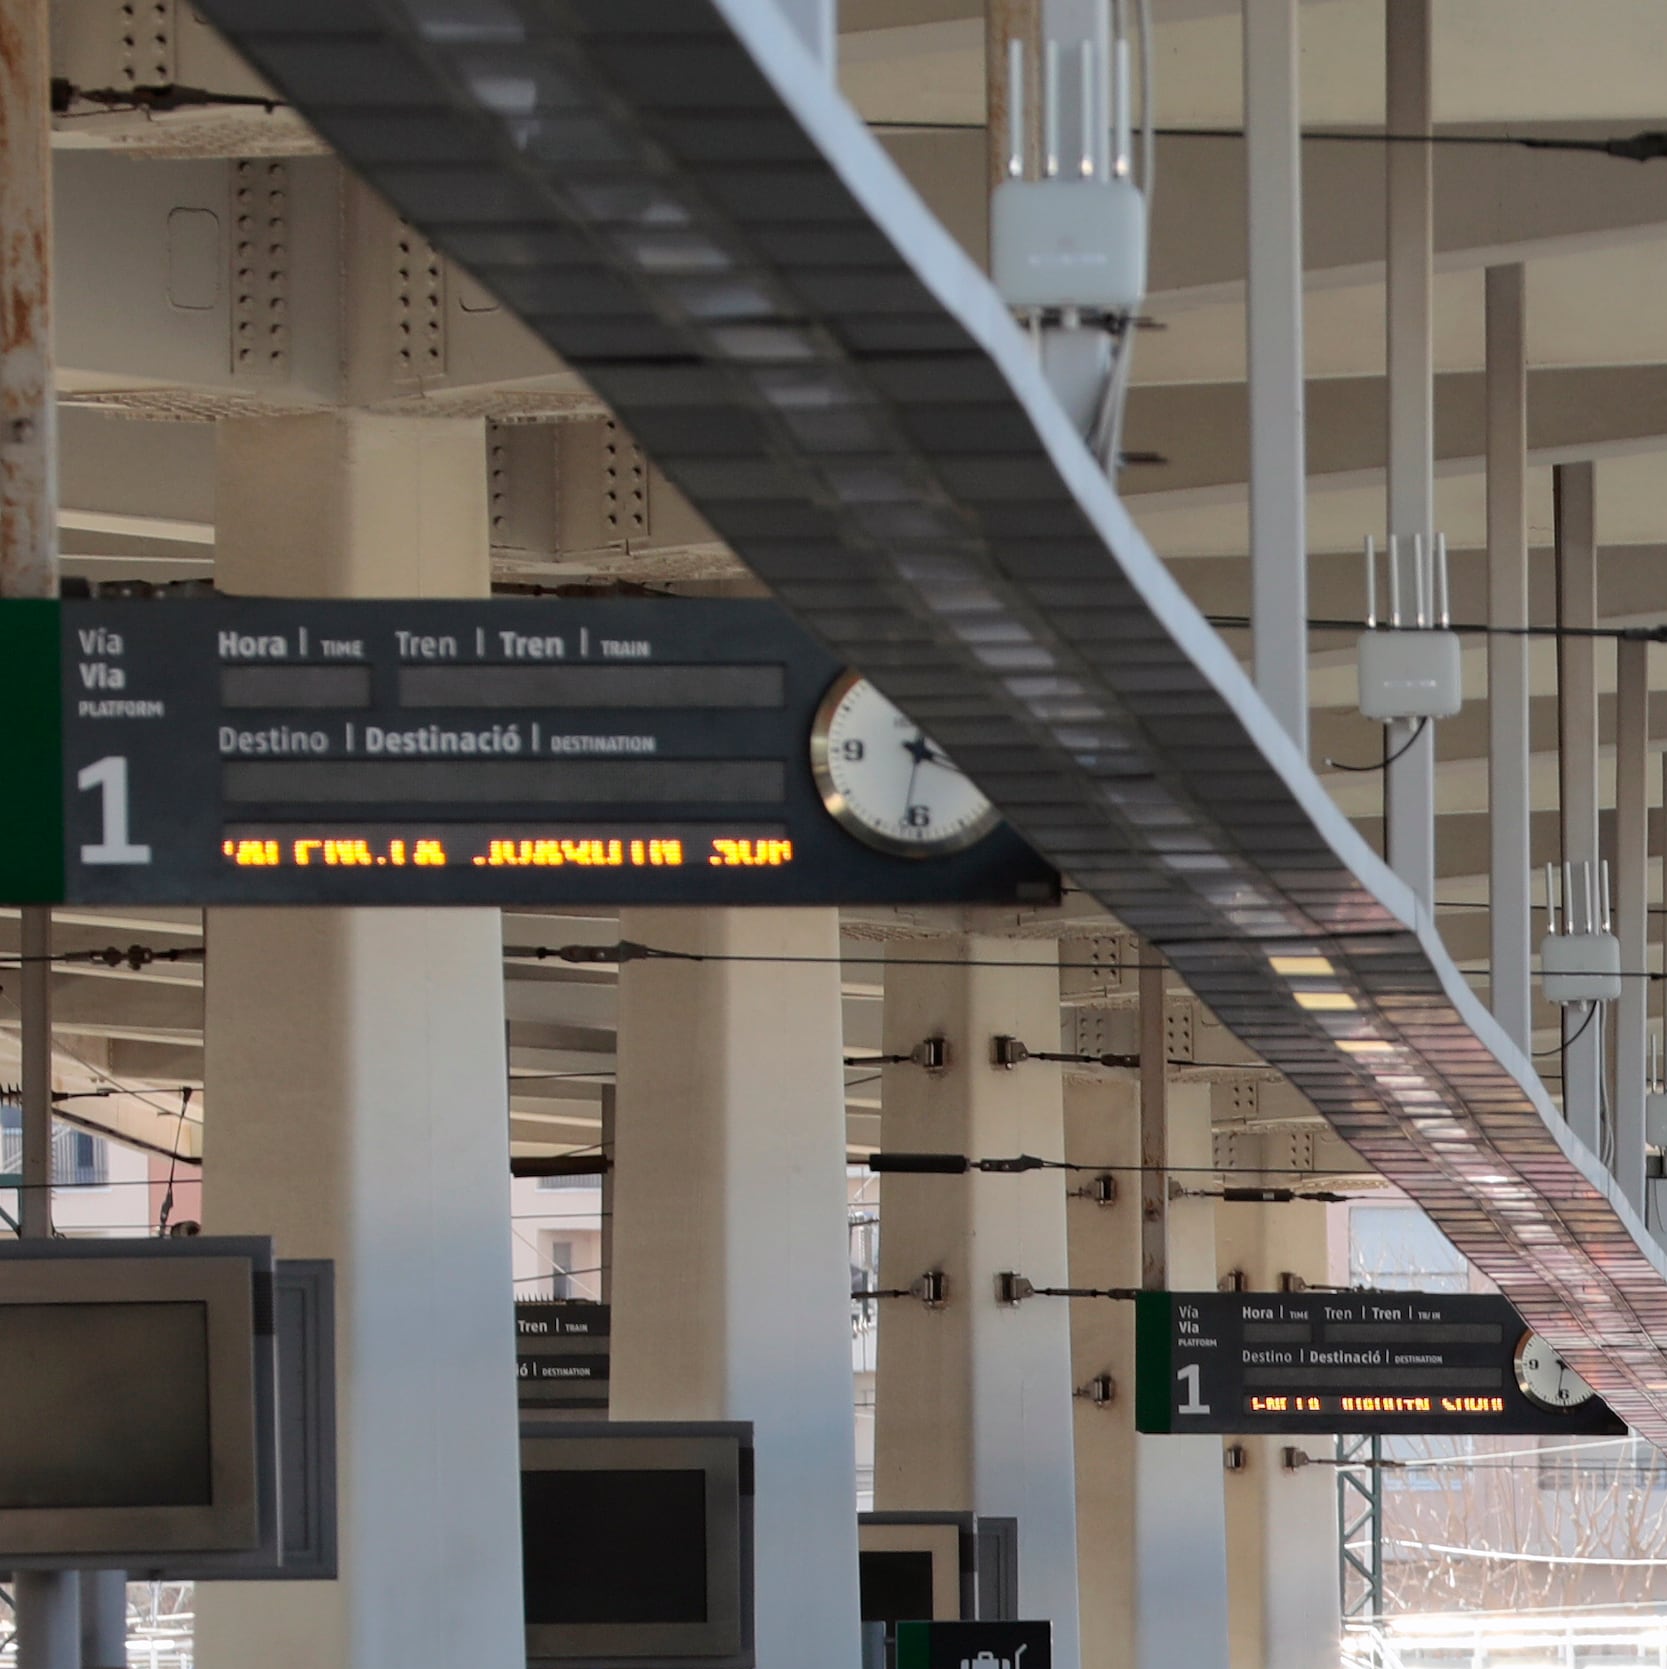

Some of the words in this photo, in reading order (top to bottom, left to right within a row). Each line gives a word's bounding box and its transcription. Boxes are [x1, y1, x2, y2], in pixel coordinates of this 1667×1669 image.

[78, 627, 124, 656] Vía
[218, 631, 288, 658] Hora
[320, 640, 364, 658] TIME
[395, 631, 457, 658] Tren
[499, 631, 564, 658] Tren
[600, 640, 651, 658] TRAIN
[79, 662, 126, 689] Via
[78, 700, 165, 718] PLATFORM
[218, 726, 329, 753] Destino
[366, 724, 521, 753] Destinació
[550, 736, 656, 753] DESTINATION
[844, 739, 864, 762] 9
[77, 755, 152, 865] 1
[908, 805, 930, 827] 6
[1242, 1306, 1274, 1320] Hora
[1289, 1310, 1309, 1320] TIME
[1324, 1306, 1352, 1320] Tren
[1371, 1306, 1401, 1320] Tren
[517, 1320, 548, 1333] Tren
[565, 1323, 588, 1333] TRAIN
[1179, 1320, 1200, 1334] Via
[1178, 1338, 1218, 1348] PLATFORM
[1242, 1349, 1292, 1363] Destino
[1310, 1349, 1381, 1364] Destinació
[1394, 1354, 1443, 1365] DESTINATION
[1529, 1359, 1539, 1370] 9
[542, 1367, 591, 1377] DESTINATION
[1176, 1363, 1211, 1415] 1
